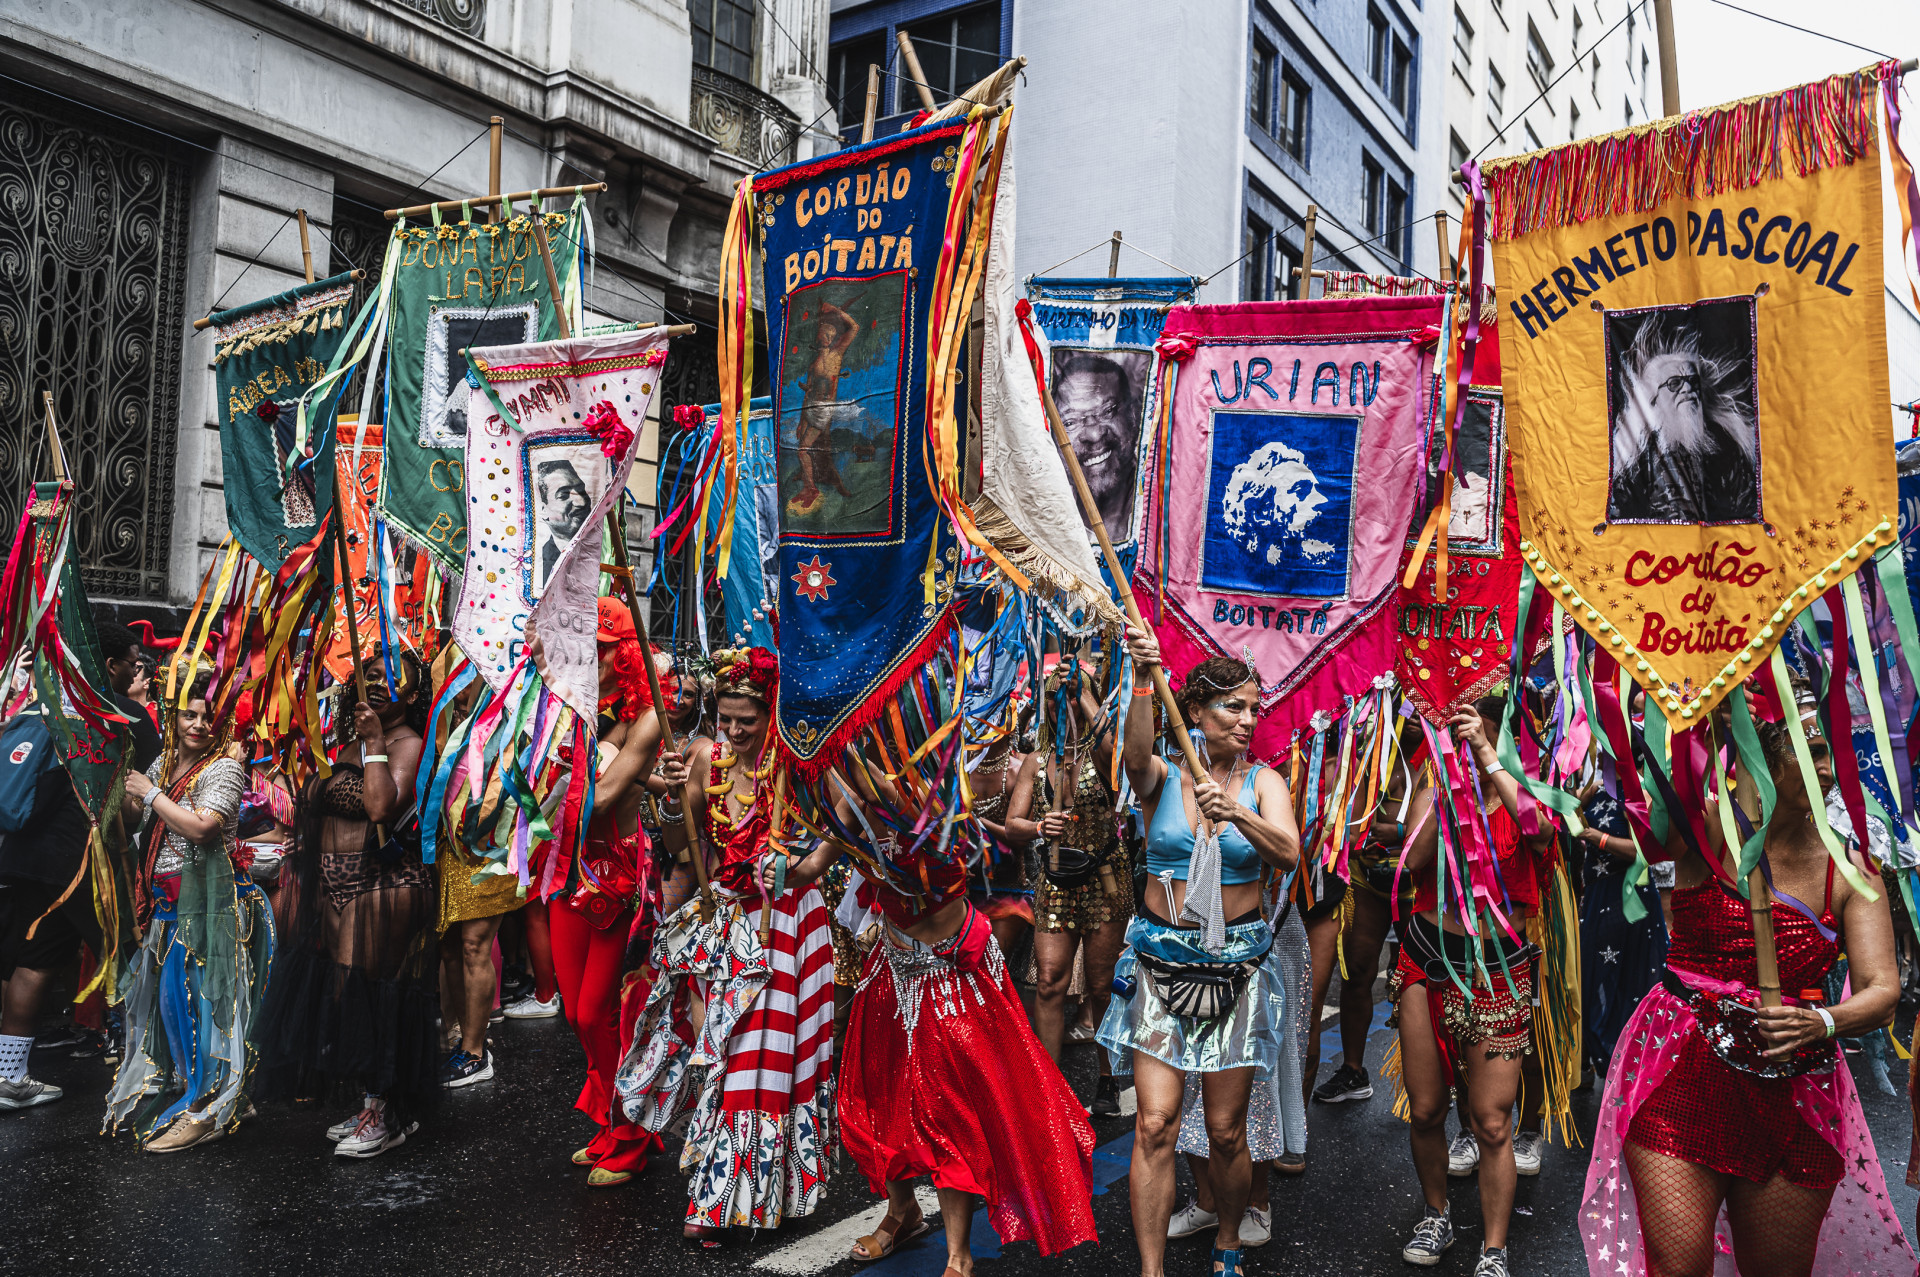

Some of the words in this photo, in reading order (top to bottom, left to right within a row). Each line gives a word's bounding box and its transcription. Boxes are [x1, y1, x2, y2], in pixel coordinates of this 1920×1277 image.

[795, 161, 911, 228] CORDÃO
[857, 207, 882, 232] DO
[401, 235, 478, 269] DONA
[446, 263, 525, 300] LARA
[1510, 216, 1677, 340] HERMETO
[1687, 207, 1860, 297] PASCOAL
[1034, 309, 1116, 331] MARTINHO
[1210, 357, 1381, 407] URIAN
[1624, 540, 1773, 588] Cordão
[1212, 599, 1334, 636] BOITATÁ
[1680, 585, 1717, 615] do
[1636, 611, 1751, 656] Boitatá
